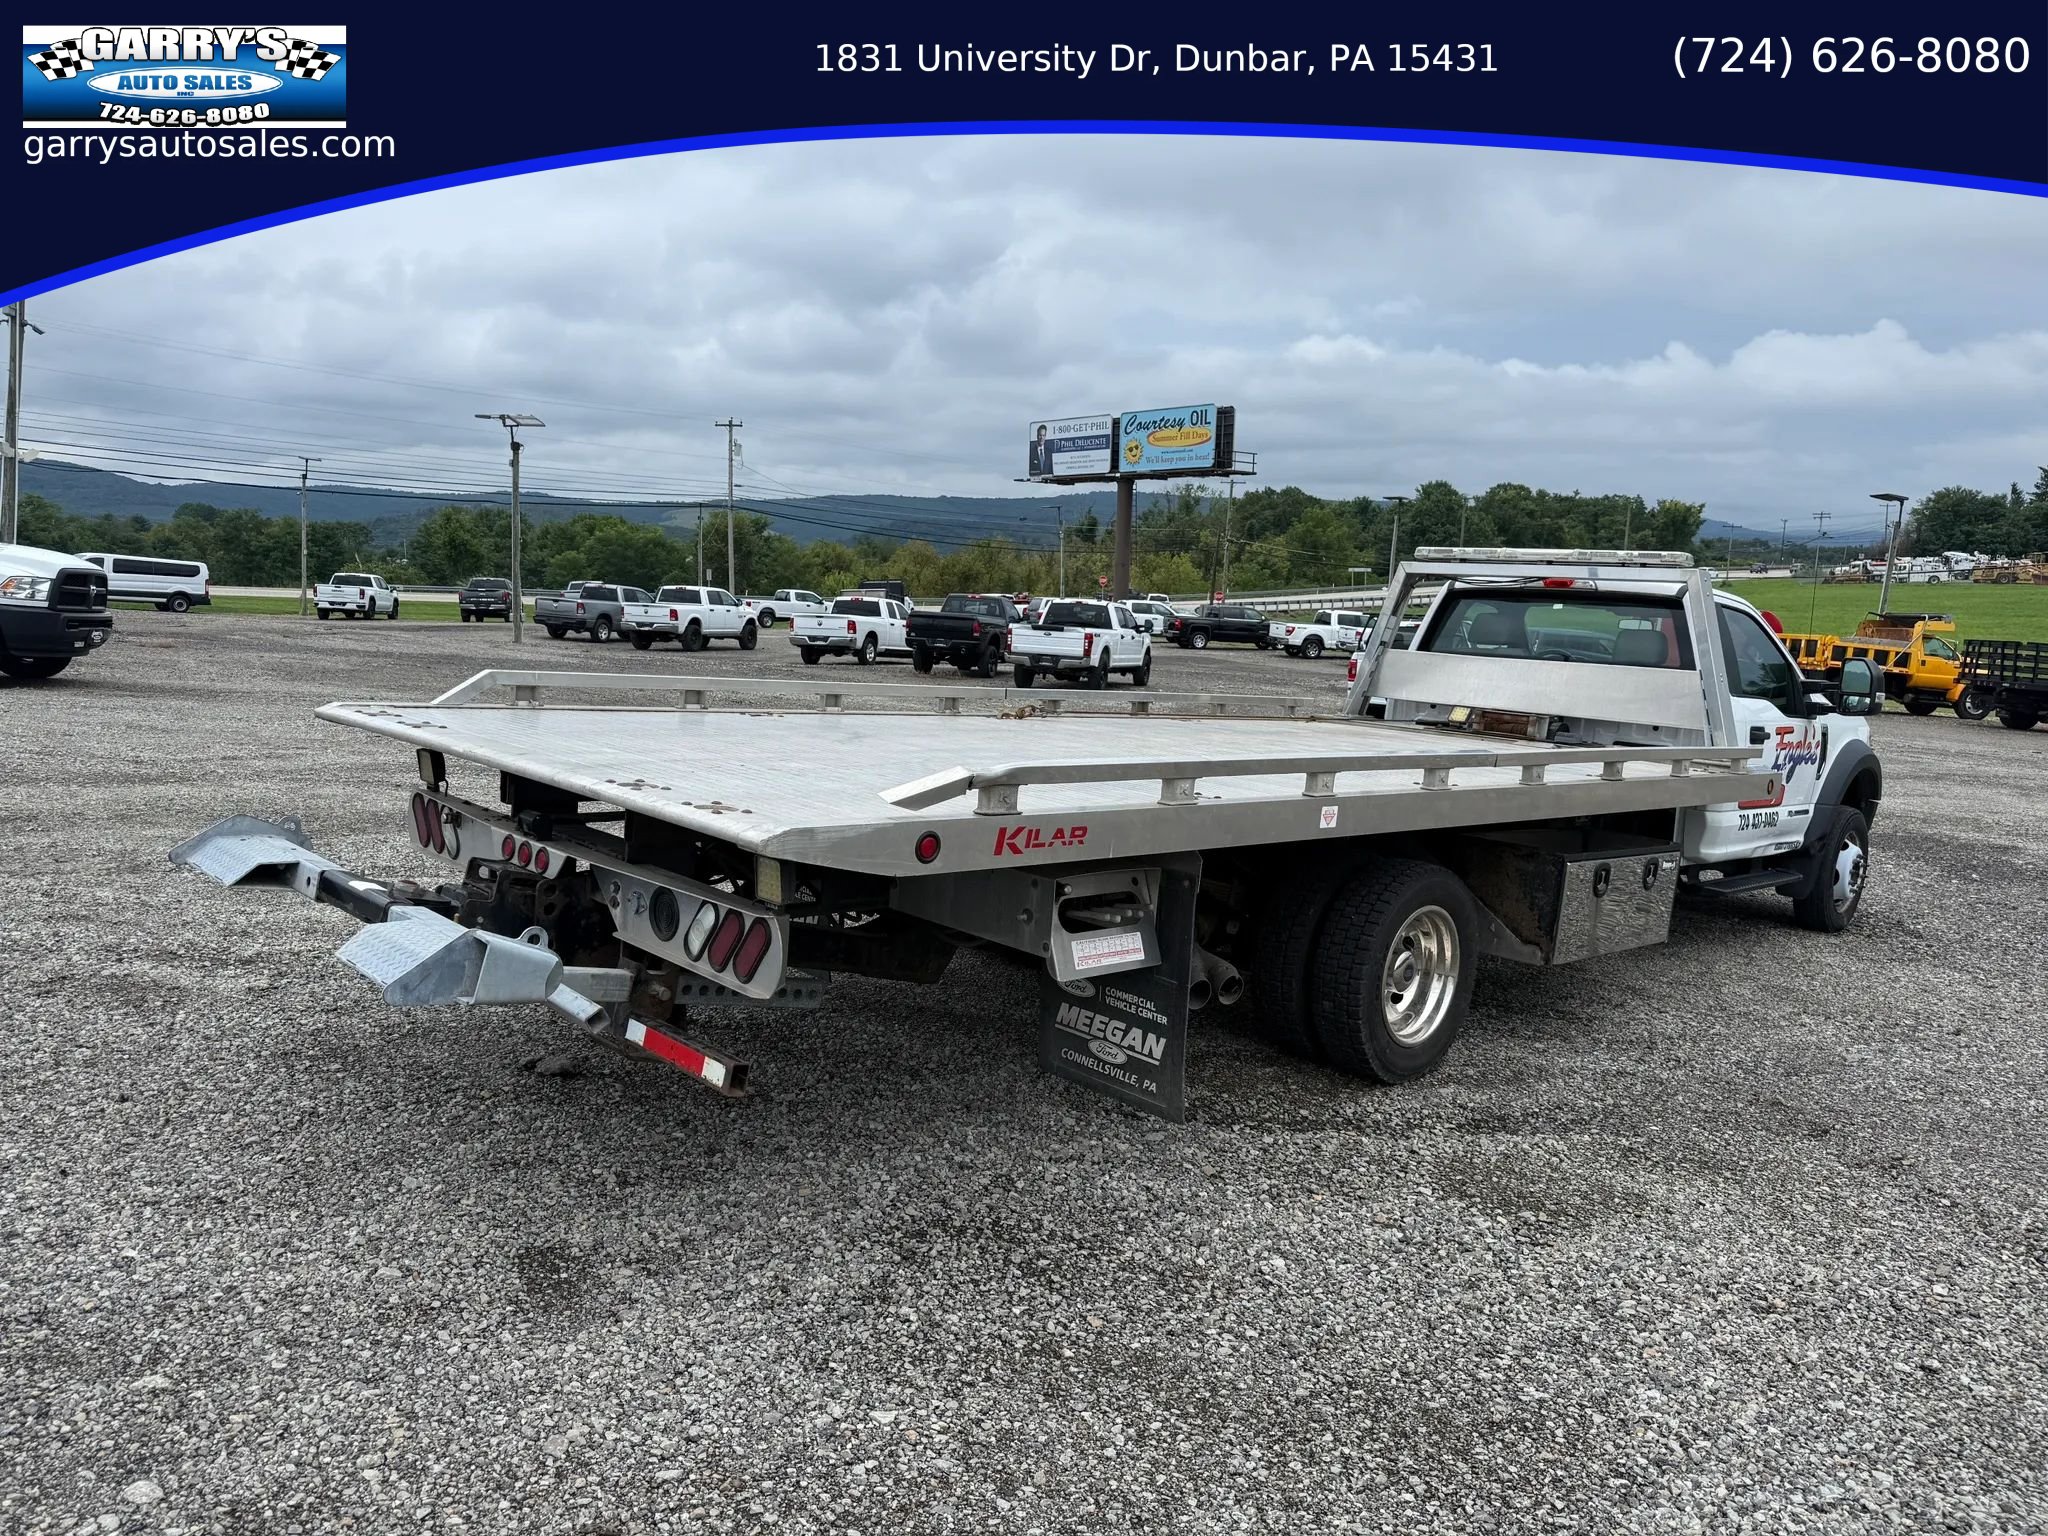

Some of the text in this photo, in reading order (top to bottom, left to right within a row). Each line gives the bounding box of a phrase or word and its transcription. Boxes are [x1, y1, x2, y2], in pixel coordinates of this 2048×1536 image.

[1053, 421, 1109, 434] 1-800-GET-PHIL
[1124, 409, 1211, 435] Courtesy OIL
[1180, 430, 1190, 441] Fill
[1192, 430, 1209, 441] Days
[1738, 813, 1750, 831] 724
[993, 825, 1088, 857] KILAR
[1105, 986, 1156, 1011] COMMERCIAL
[1105, 995, 1168, 1025] VEHICLE CENTER
[1056, 1002, 1167, 1060] MEEGAN
[1095, 1043, 1119, 1061] Ford
[1061, 1048, 1157, 1094] CONNELLSVILLE, PA
